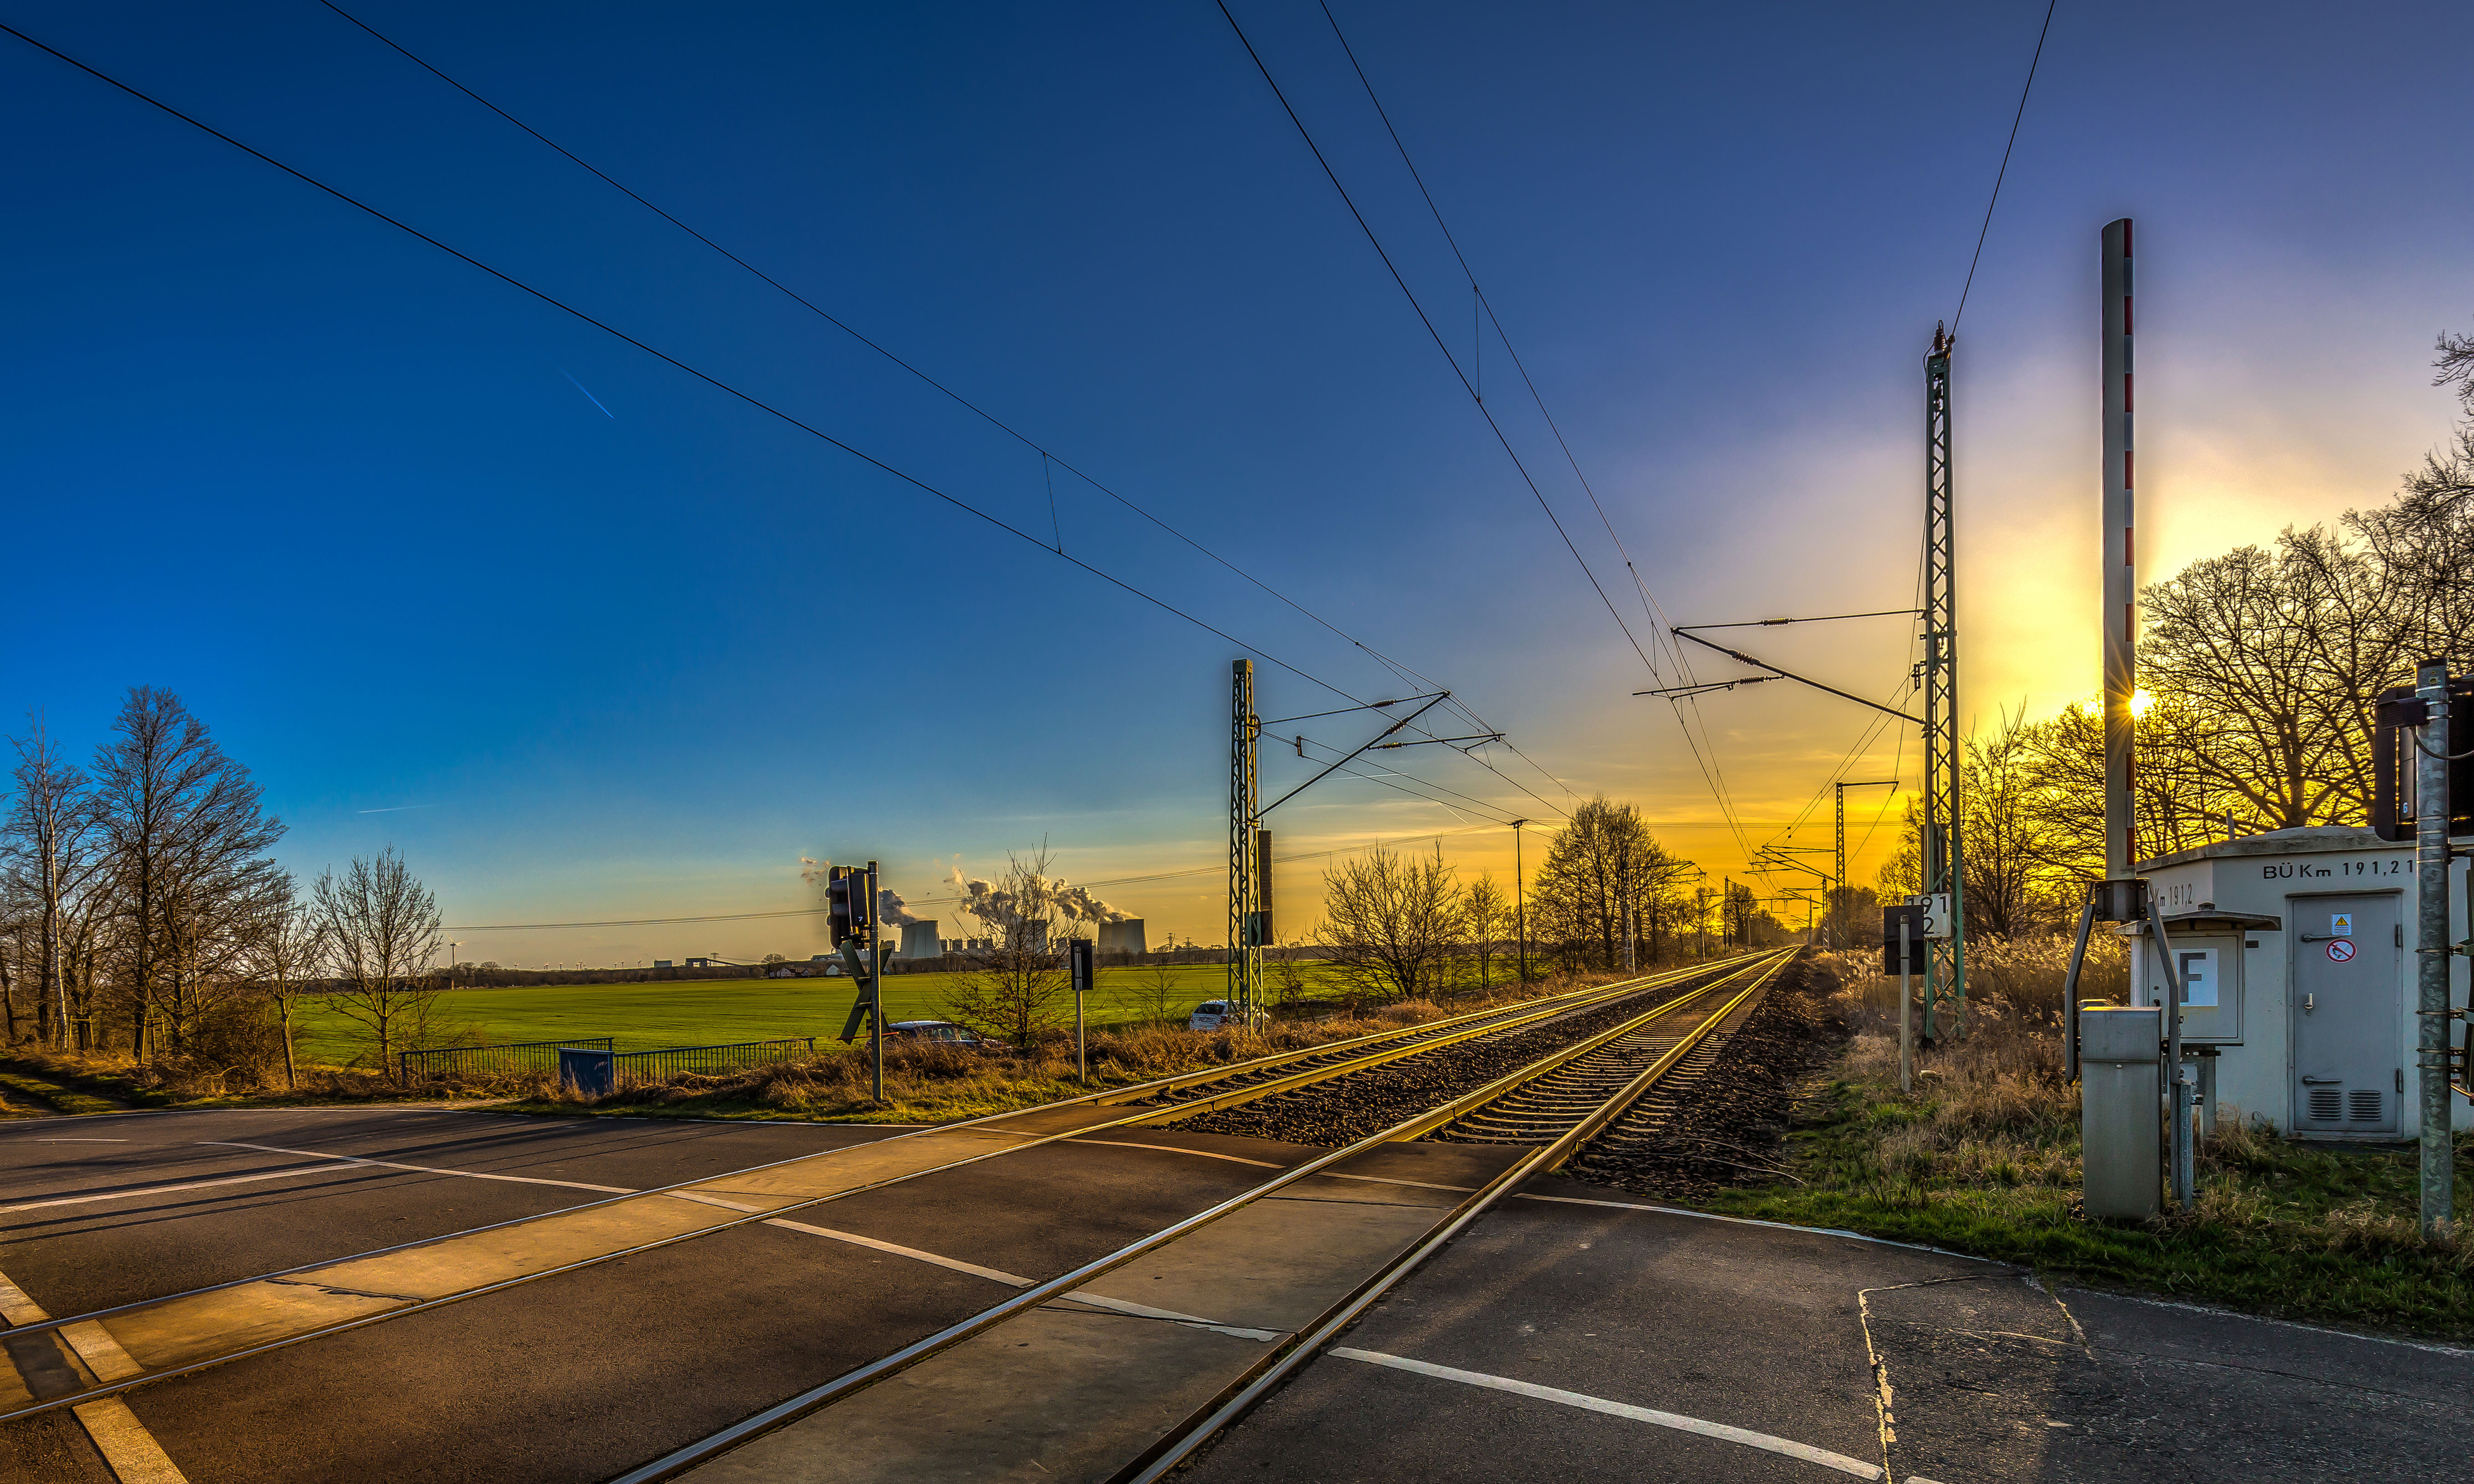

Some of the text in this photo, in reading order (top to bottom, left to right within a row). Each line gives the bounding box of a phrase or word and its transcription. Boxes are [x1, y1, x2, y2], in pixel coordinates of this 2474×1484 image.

[2263, 860, 2413, 879] BÜ Km 191,21
[2169, 883, 2192, 908] 191,2
[1924, 917, 1935, 934] 2
[2179, 952, 2206, 1003] F
